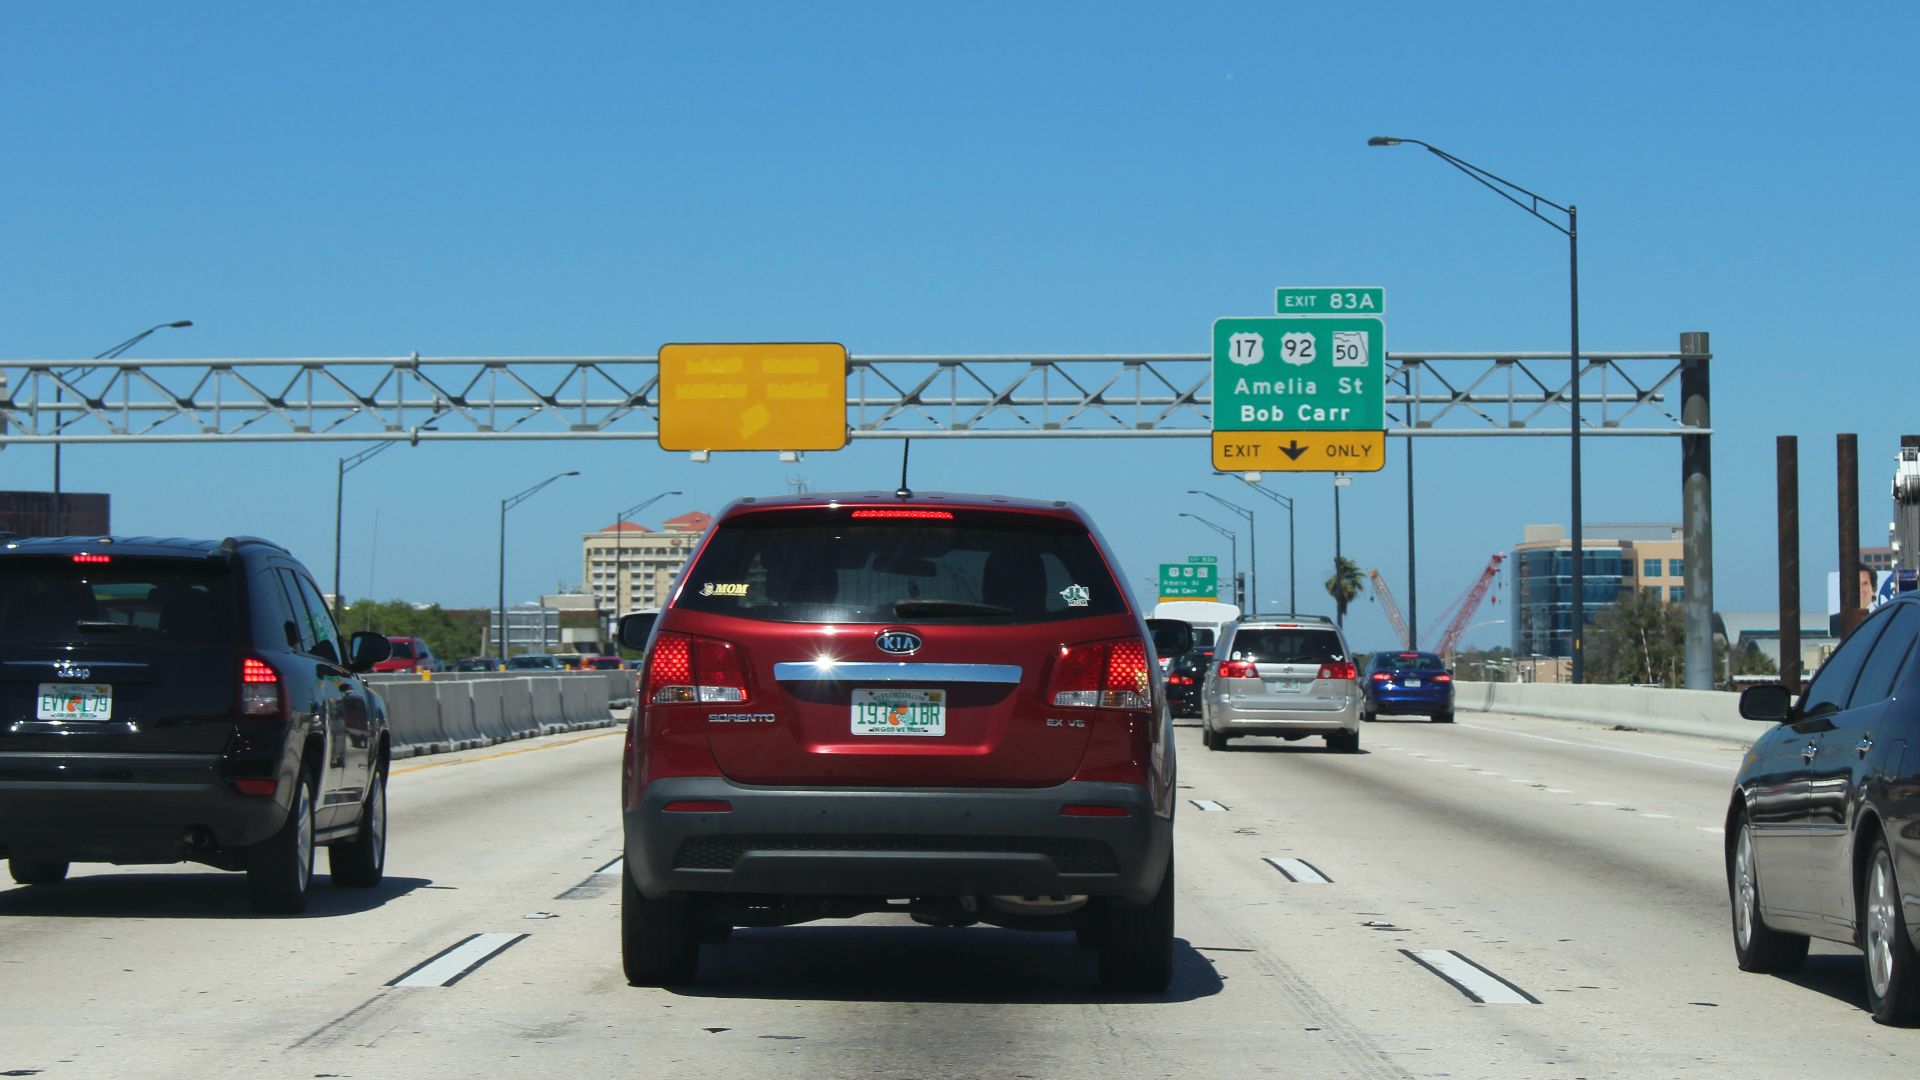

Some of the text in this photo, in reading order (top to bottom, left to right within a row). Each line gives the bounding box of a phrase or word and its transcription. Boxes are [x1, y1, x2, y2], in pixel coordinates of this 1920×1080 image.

[1284, 293, 1375, 309] EXIT 83A
[1235, 339, 1359, 360] 17 92 50
[1233, 377, 1363, 395] Amelia St
[1240, 404, 1350, 422] Bob Carr
[1223, 444, 1372, 457] EXIT ONLY
[715, 583, 749, 594] MOM
[884, 637, 914, 649] KIA
[58, 664, 90, 679] Jeep
[83, 694, 107, 712] L79
[708, 713, 776, 723] SORENTO
[858, 702, 940, 725] 193 1BR
[1068, 719, 1086, 728] V6
